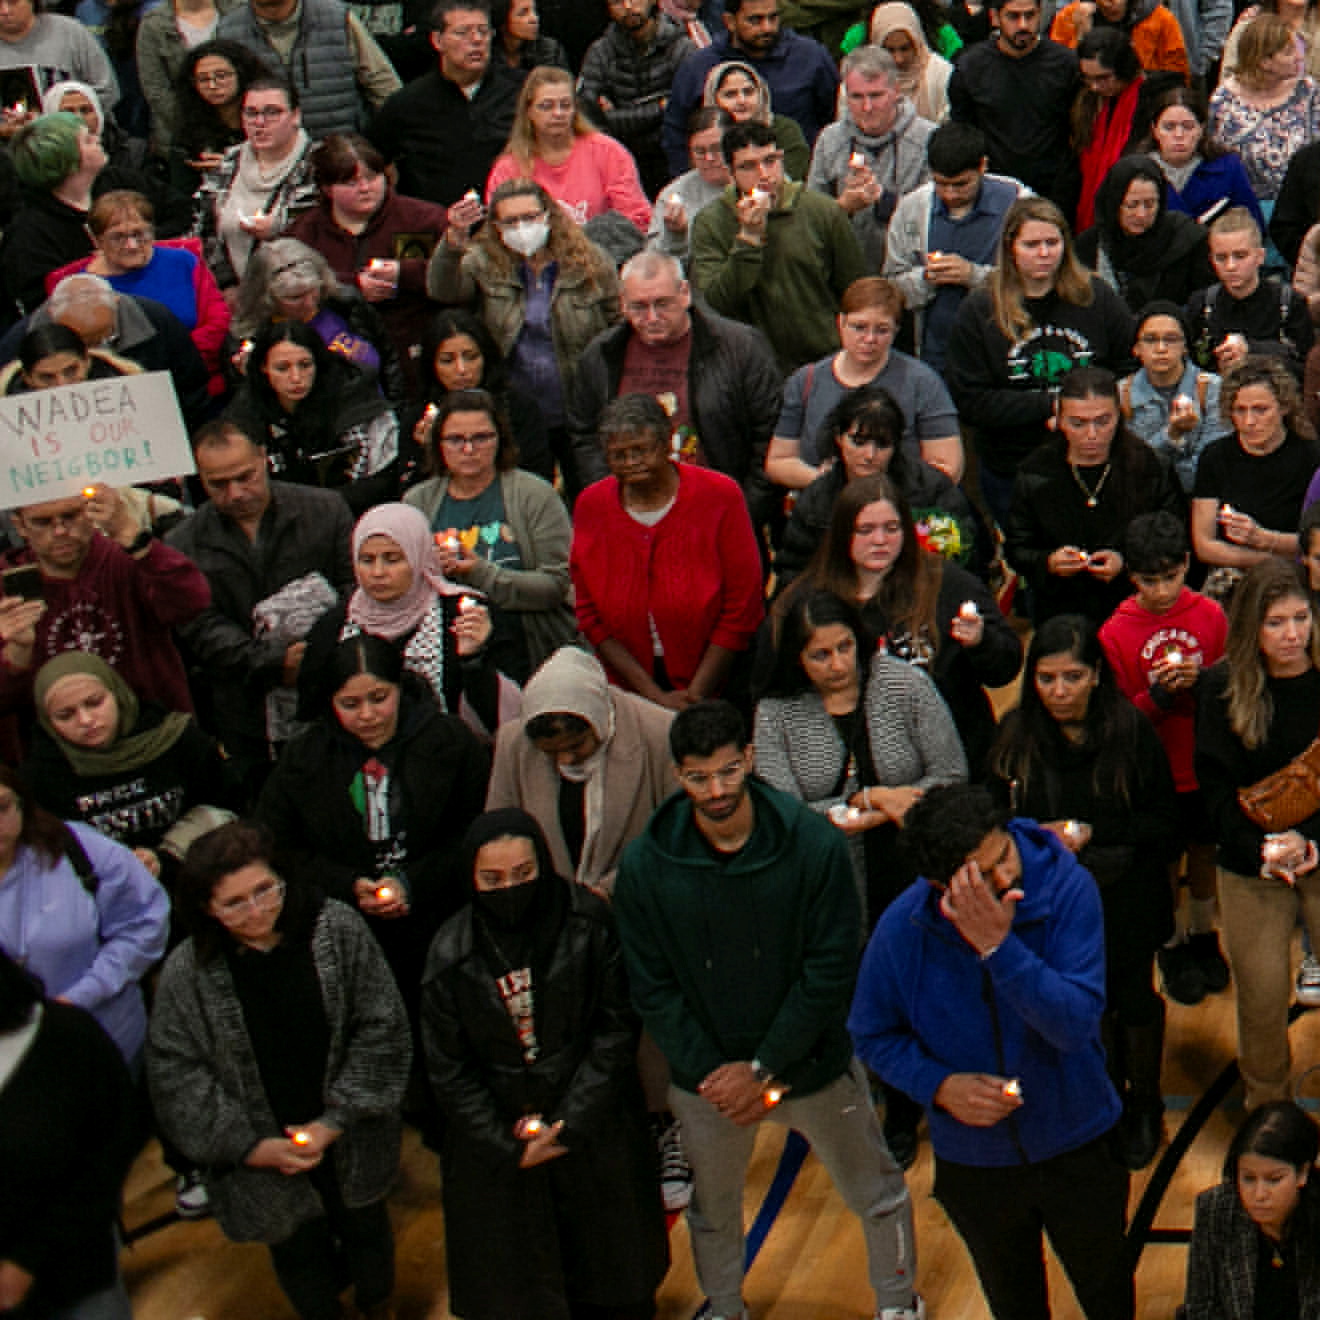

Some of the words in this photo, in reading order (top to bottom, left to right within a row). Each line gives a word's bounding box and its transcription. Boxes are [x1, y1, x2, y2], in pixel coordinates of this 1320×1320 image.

[0, 383, 137, 440] WADEA
[30, 432, 62, 457] IS
[90, 417, 142, 445] OUR
